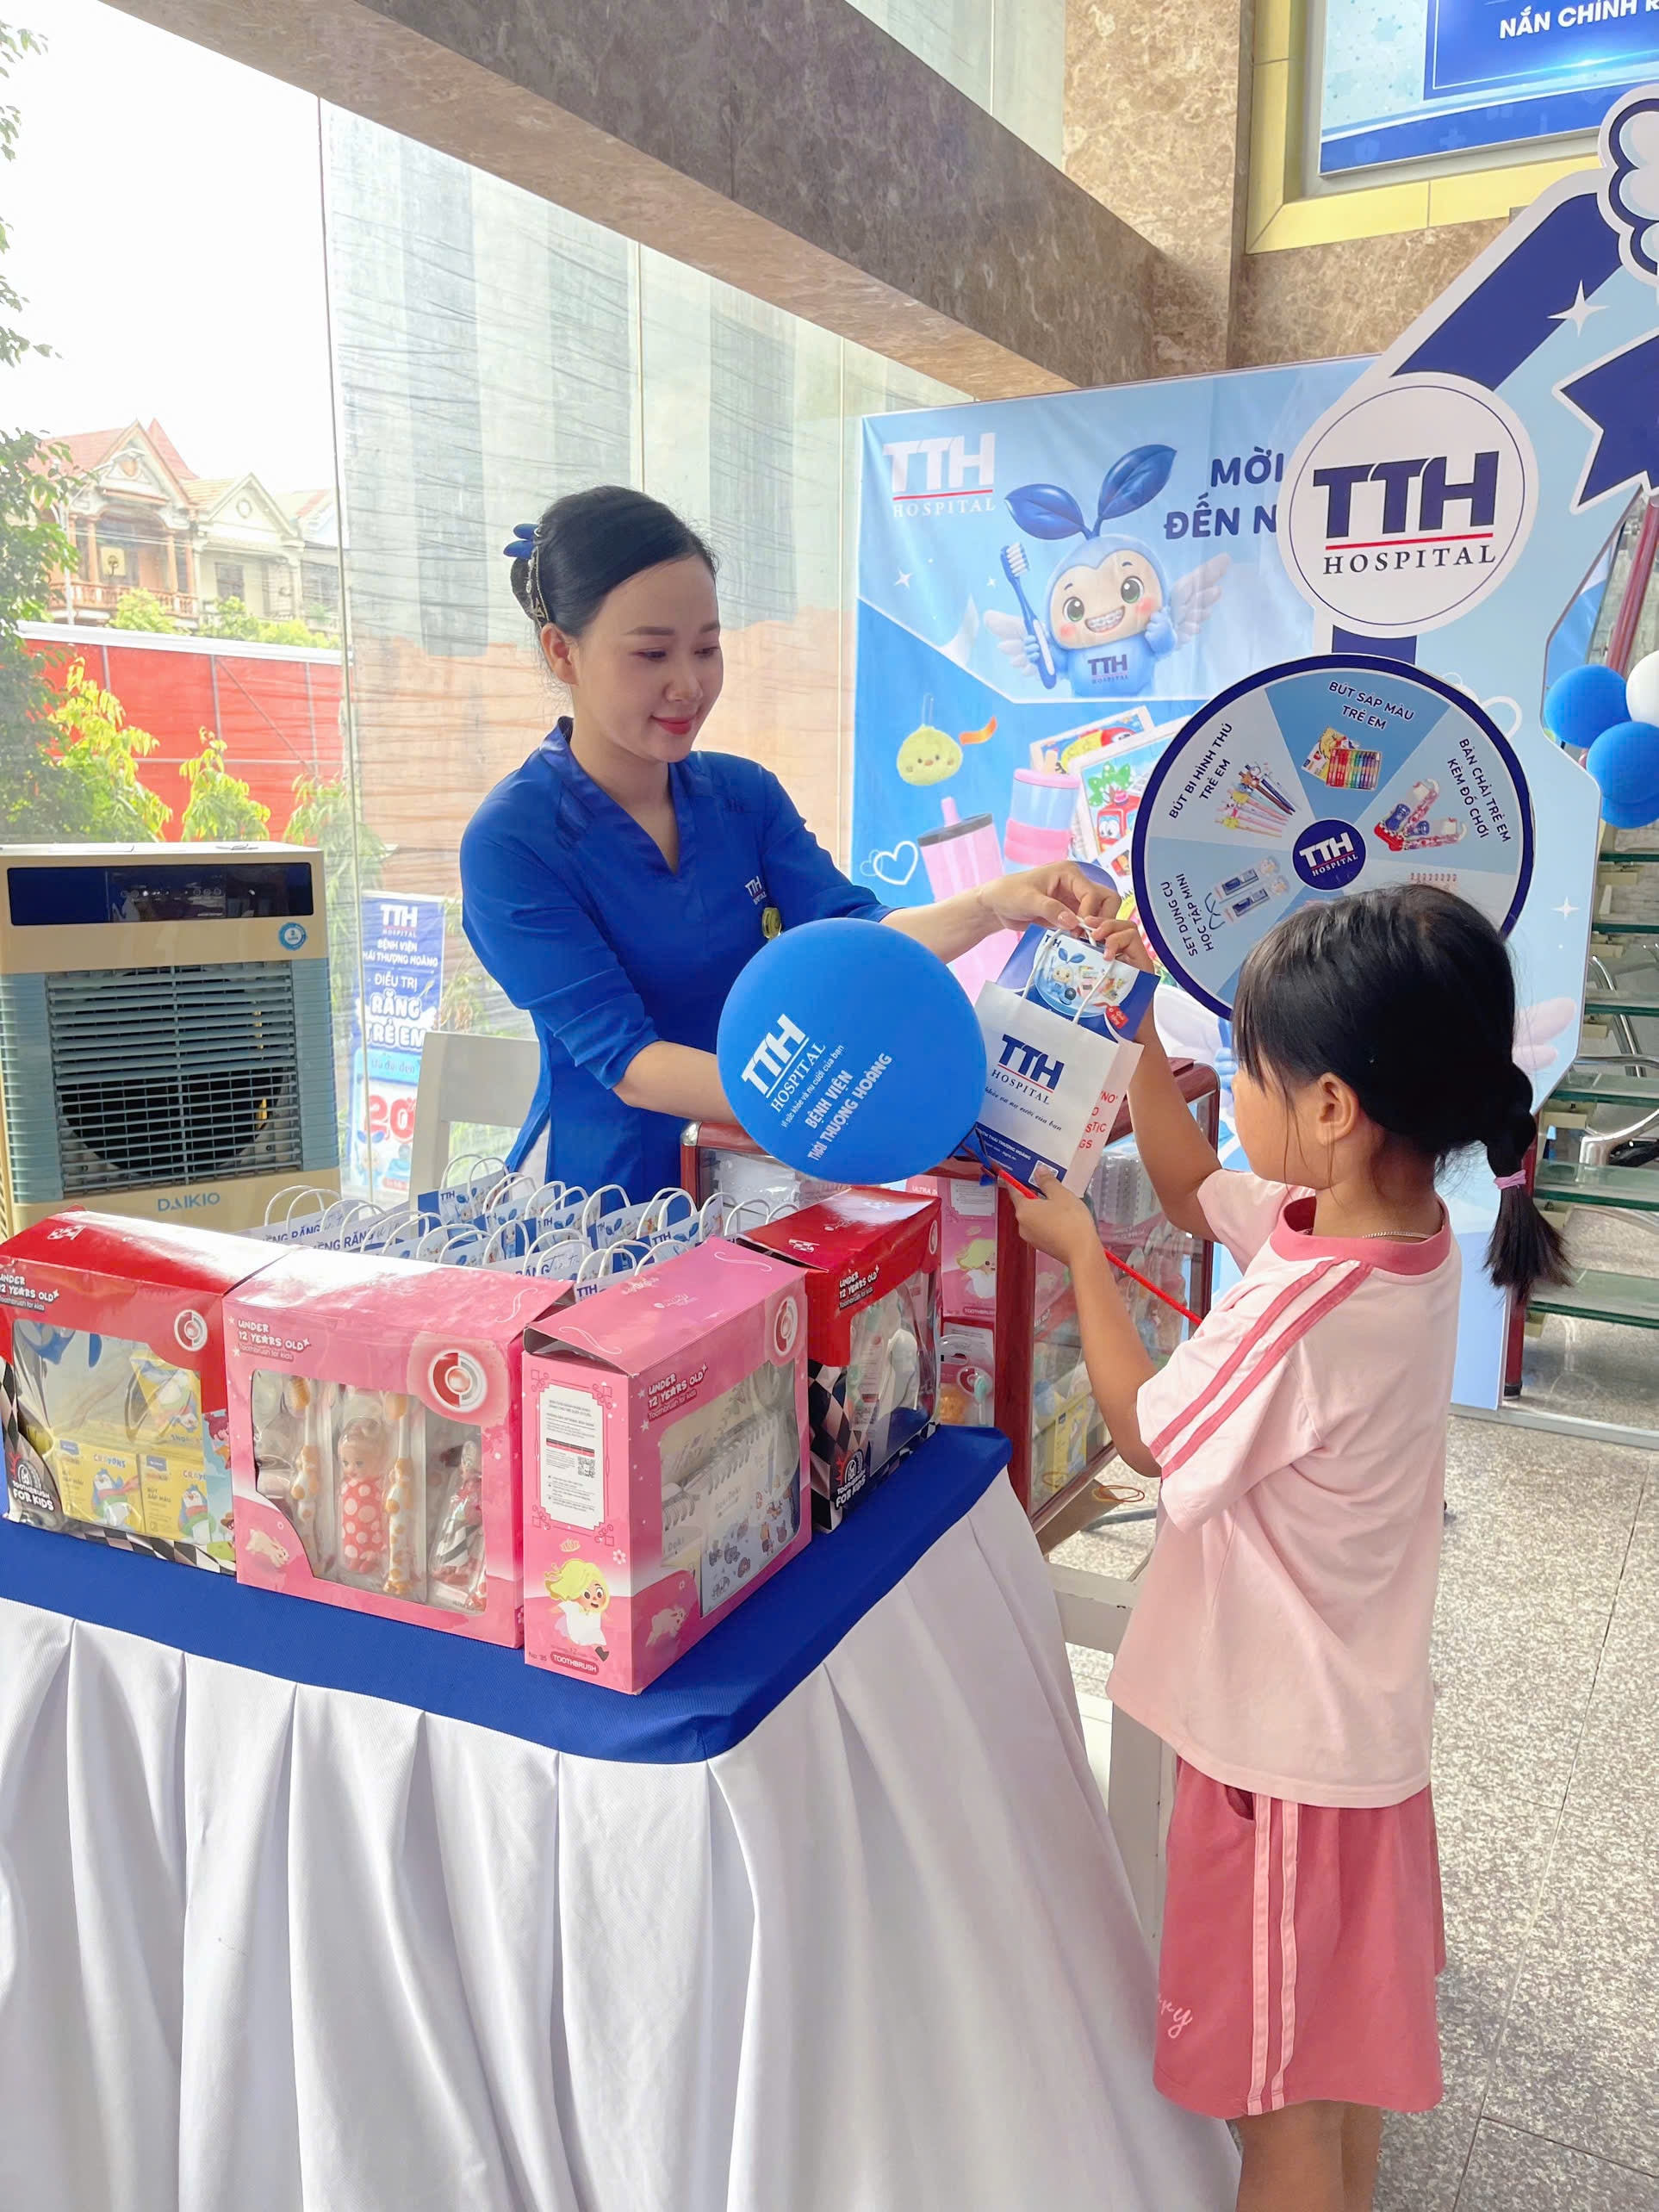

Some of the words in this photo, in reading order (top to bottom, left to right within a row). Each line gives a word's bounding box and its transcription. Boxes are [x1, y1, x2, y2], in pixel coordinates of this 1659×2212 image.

[1500, 5, 1550, 39] NẮN
[882, 432, 996, 493] TTH
[1210, 446, 1283, 488] MỜI
[1313, 450, 1500, 538] TTH
[892, 497, 995, 518] HOSPITAL
[1164, 492, 1240, 539] ĐẾN
[1323, 544, 1496, 575] HOSPITAL
[1087, 654, 1128, 675] TTH
[1367, 716, 1387, 730] EM
[1215, 759, 1231, 777] EM
[1184, 780, 1197, 793] BI
[1496, 823, 1512, 842] EM
[1299, 832, 1354, 868] TTH
[1312, 854, 1358, 877] HOSPITAL
[1176, 873, 1192, 899] MINI
[380, 904, 418, 928] TTH
[1045, 935, 1061, 948] TH
[1183, 936, 1198, 956] SET
[363, 949, 376, 961] HÁI
[371, 990, 420, 1020] RĂNG
[399, 1026, 426, 1048] EM
[741, 1013, 806, 1095] TTH
[999, 1034, 1065, 1090] TTH
[770, 1043, 826, 1113] HOSPITAL
[851, 1053, 892, 1099] HOÀNG
[991, 1069, 1050, 1105] HOSPITAL
[805, 1097, 832, 1129] BỆNH
[825, 1069, 854, 1101] VIỆN
[158, 1192, 221, 1212] DAIKIO
[440, 1190, 455, 1201] TTH
[652, 1232, 671, 1246] TTH
[9, 1285, 36, 1298] YEARS
[39, 1292, 53, 1302] OLD
[576, 1283, 598, 1297] TTH
[238, 1320, 269, 1333] UNDER
[239, 1331, 247, 1340] 12
[251, 1333, 282, 1346] YEARS
[285, 1340, 303, 1351] OLD
[649, 1374, 676, 1395] UNDER
[649, 1395, 658, 1408] 12
[661, 1380, 687, 1401] YEARS
[689, 1371, 704, 1385] OLD
[13, 1488, 32, 1503] FOR
[32, 1494, 54, 1511] KIDS
[836, 1489, 851, 1507] FOR
[553, 1655, 597, 1672] TOOTHBRUSH
